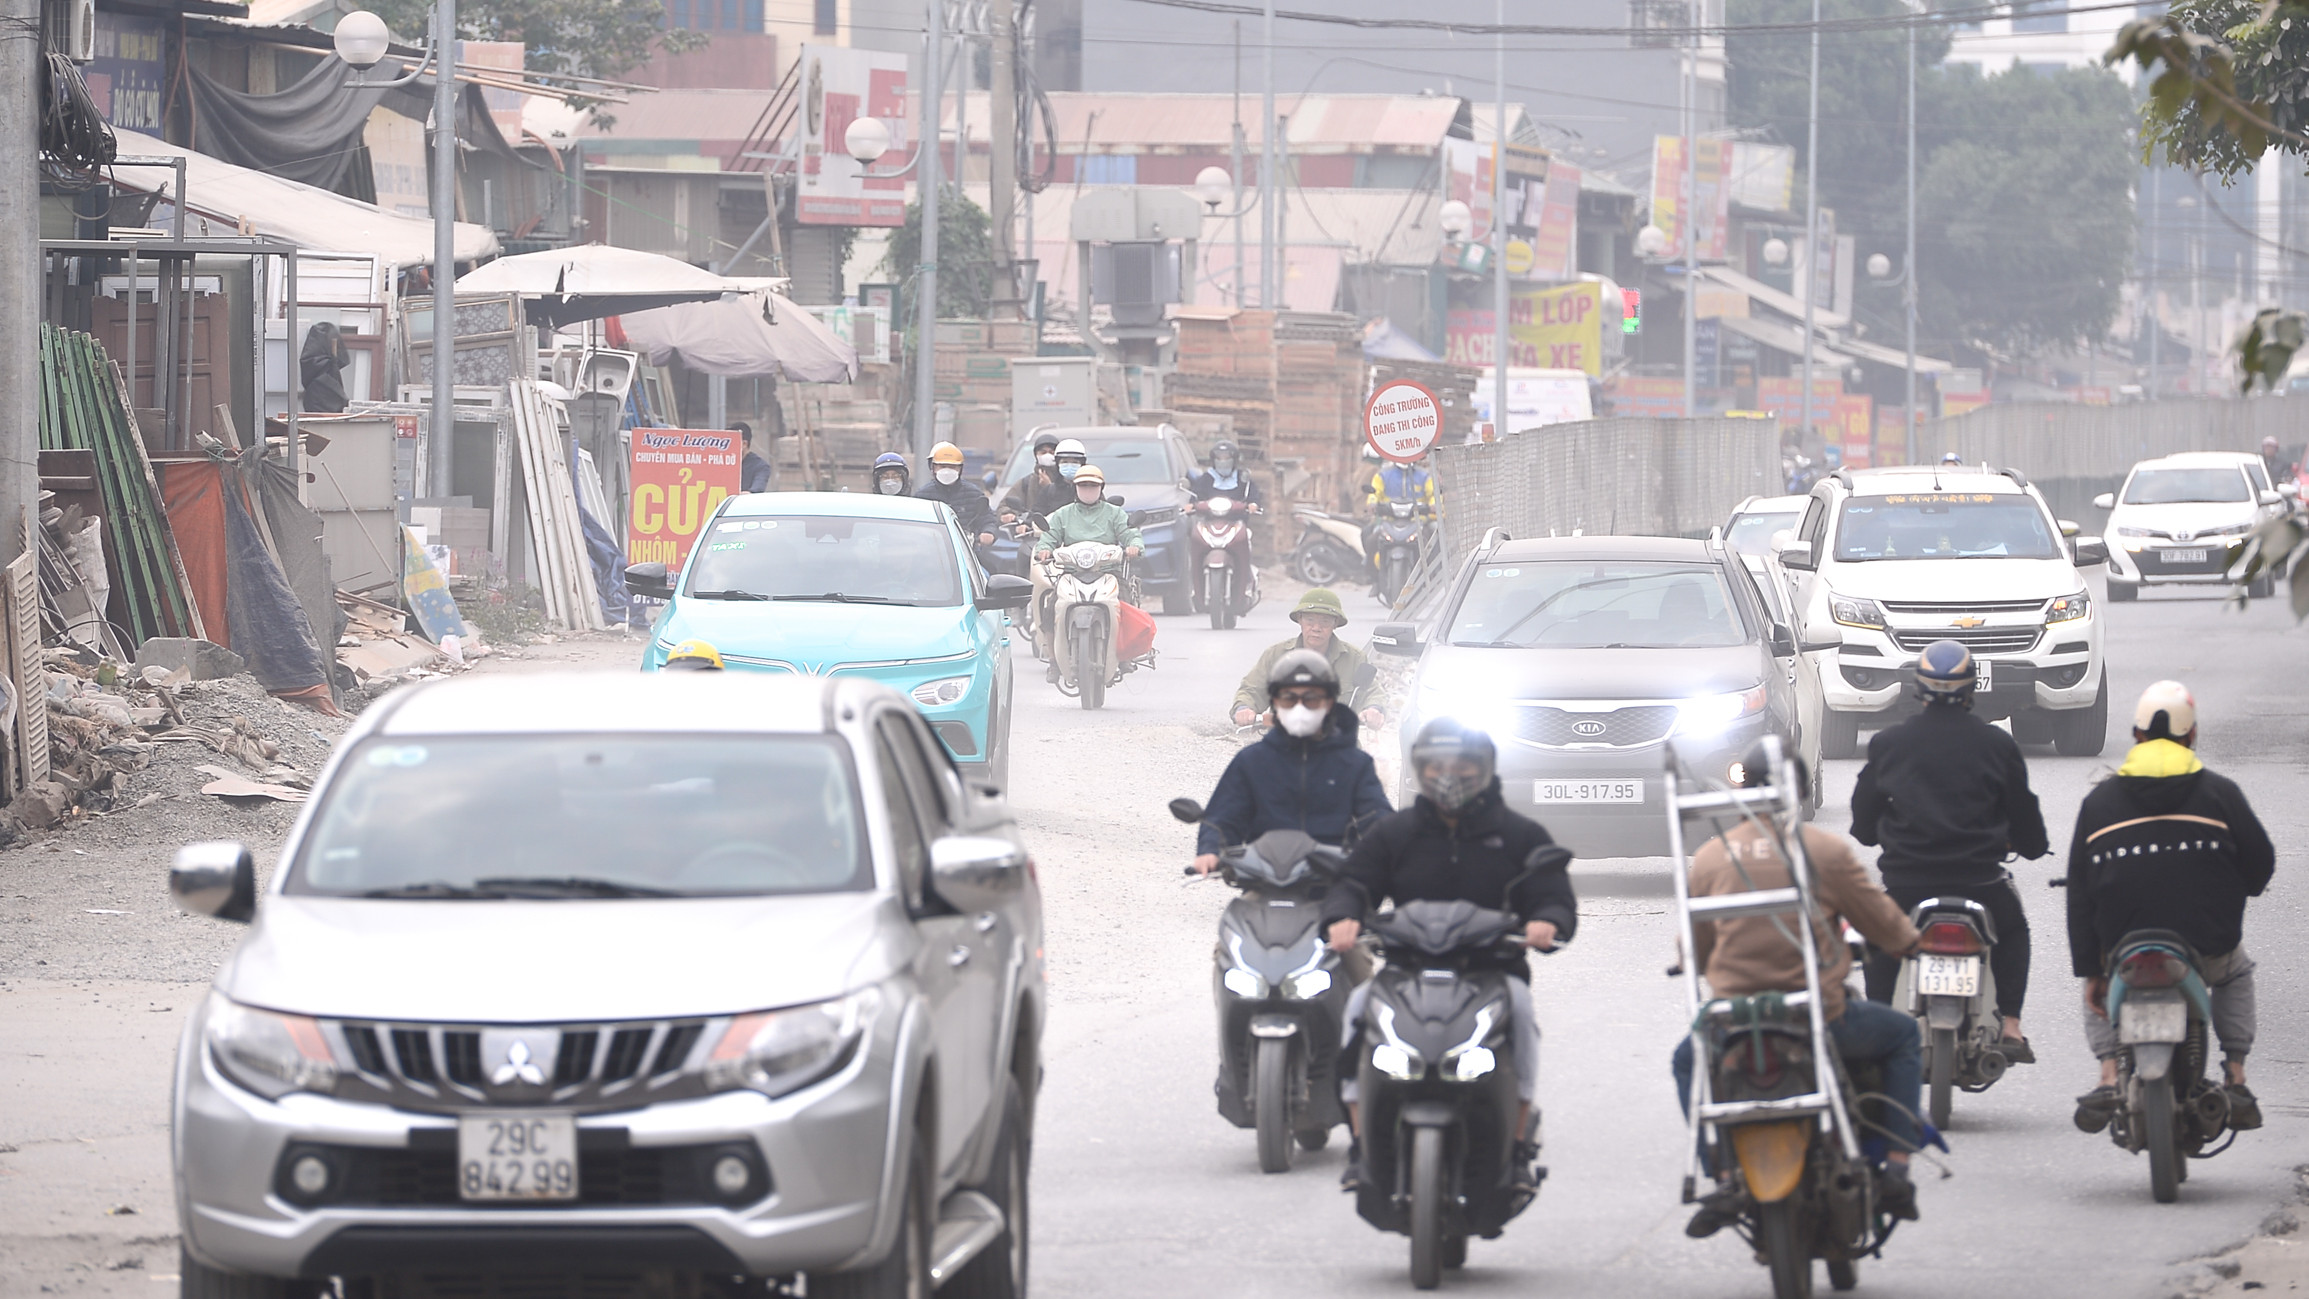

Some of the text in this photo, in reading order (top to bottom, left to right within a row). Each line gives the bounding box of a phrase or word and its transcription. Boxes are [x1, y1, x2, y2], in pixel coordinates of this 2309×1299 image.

[1550, 343, 1584, 370] XE
[1373, 396, 1430, 416] CÔNG TRƯỜNG
[1373, 415, 1434, 436] ĐANG THI CÔNG
[642, 433, 731, 450] Ngọc Lượng
[636, 450, 665, 463] CHUYÊN
[667, 453, 684, 464] MUA
[686, 451, 701, 464] BÁN
[633, 467, 728, 536] CỬA
[630, 535, 677, 564] NHÔM
[712, 542, 746, 552] TAXI
[1578, 724, 1600, 732] KIA
[1544, 784, 1634, 799] 30L-917.95
[487, 1119, 548, 1156] 29C
